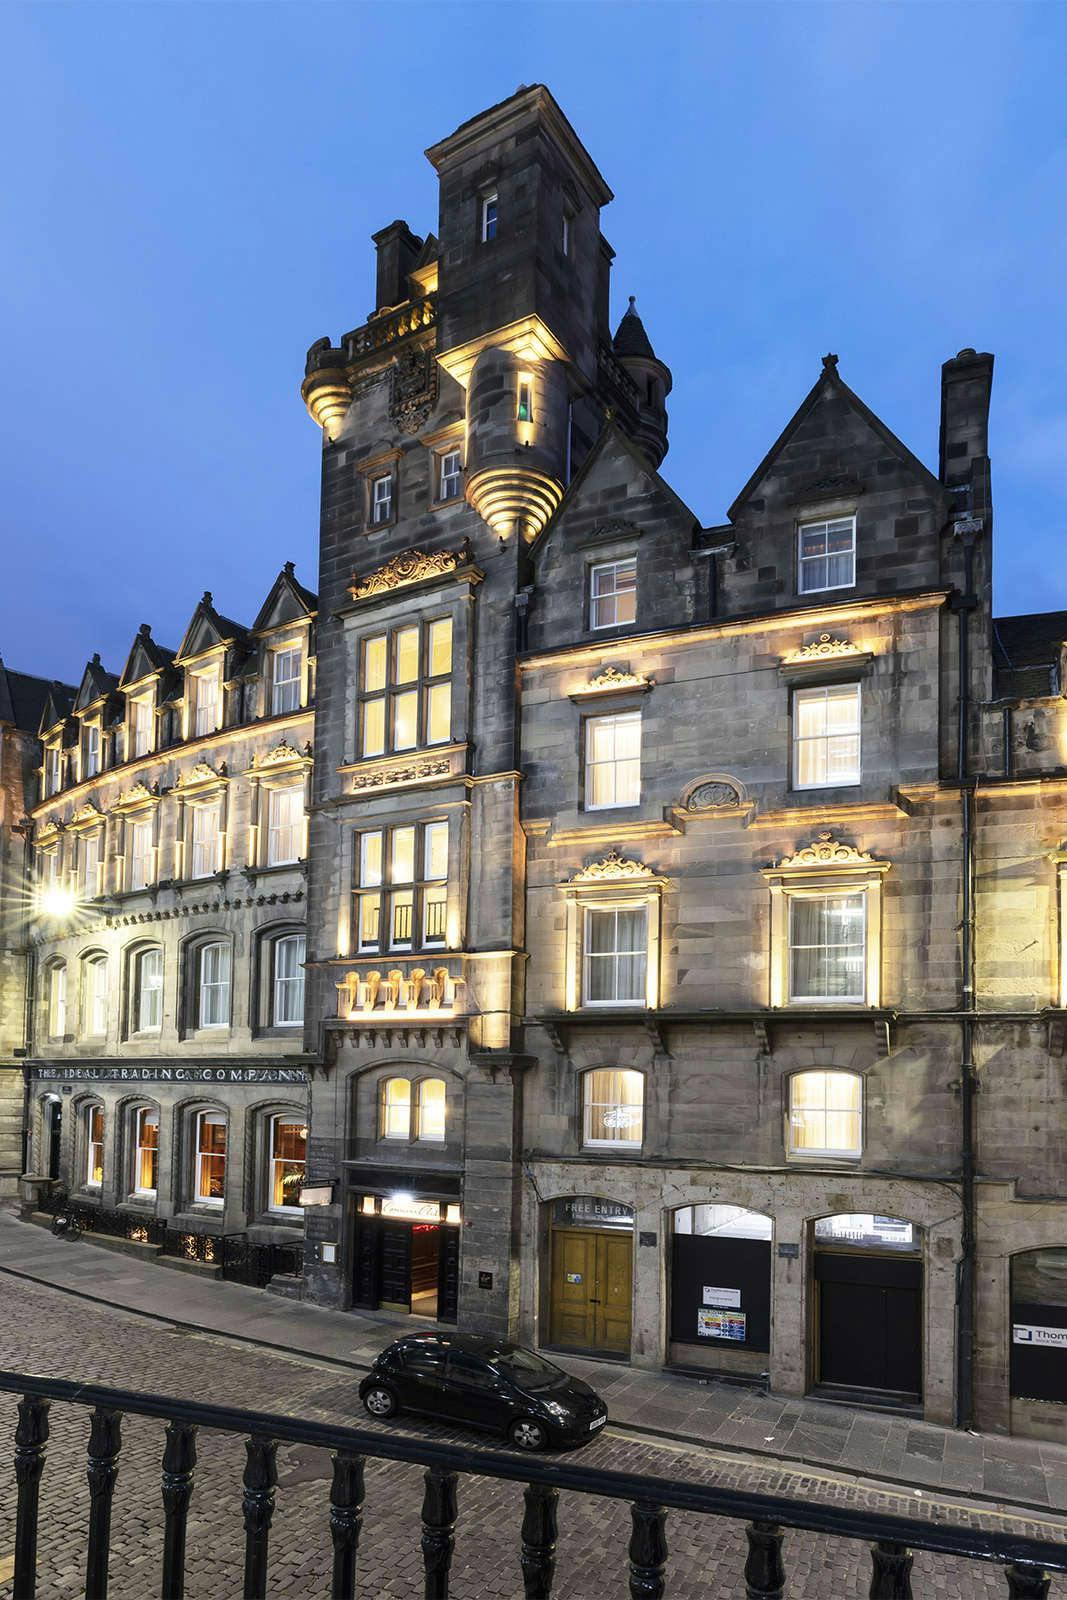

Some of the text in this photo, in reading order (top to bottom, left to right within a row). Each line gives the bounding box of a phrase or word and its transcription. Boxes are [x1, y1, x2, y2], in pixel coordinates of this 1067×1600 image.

[38, 1068, 306, 1081] THE IDEAL TRADING COMPANY
[565, 1203, 628, 1215] FREE ENTRY
